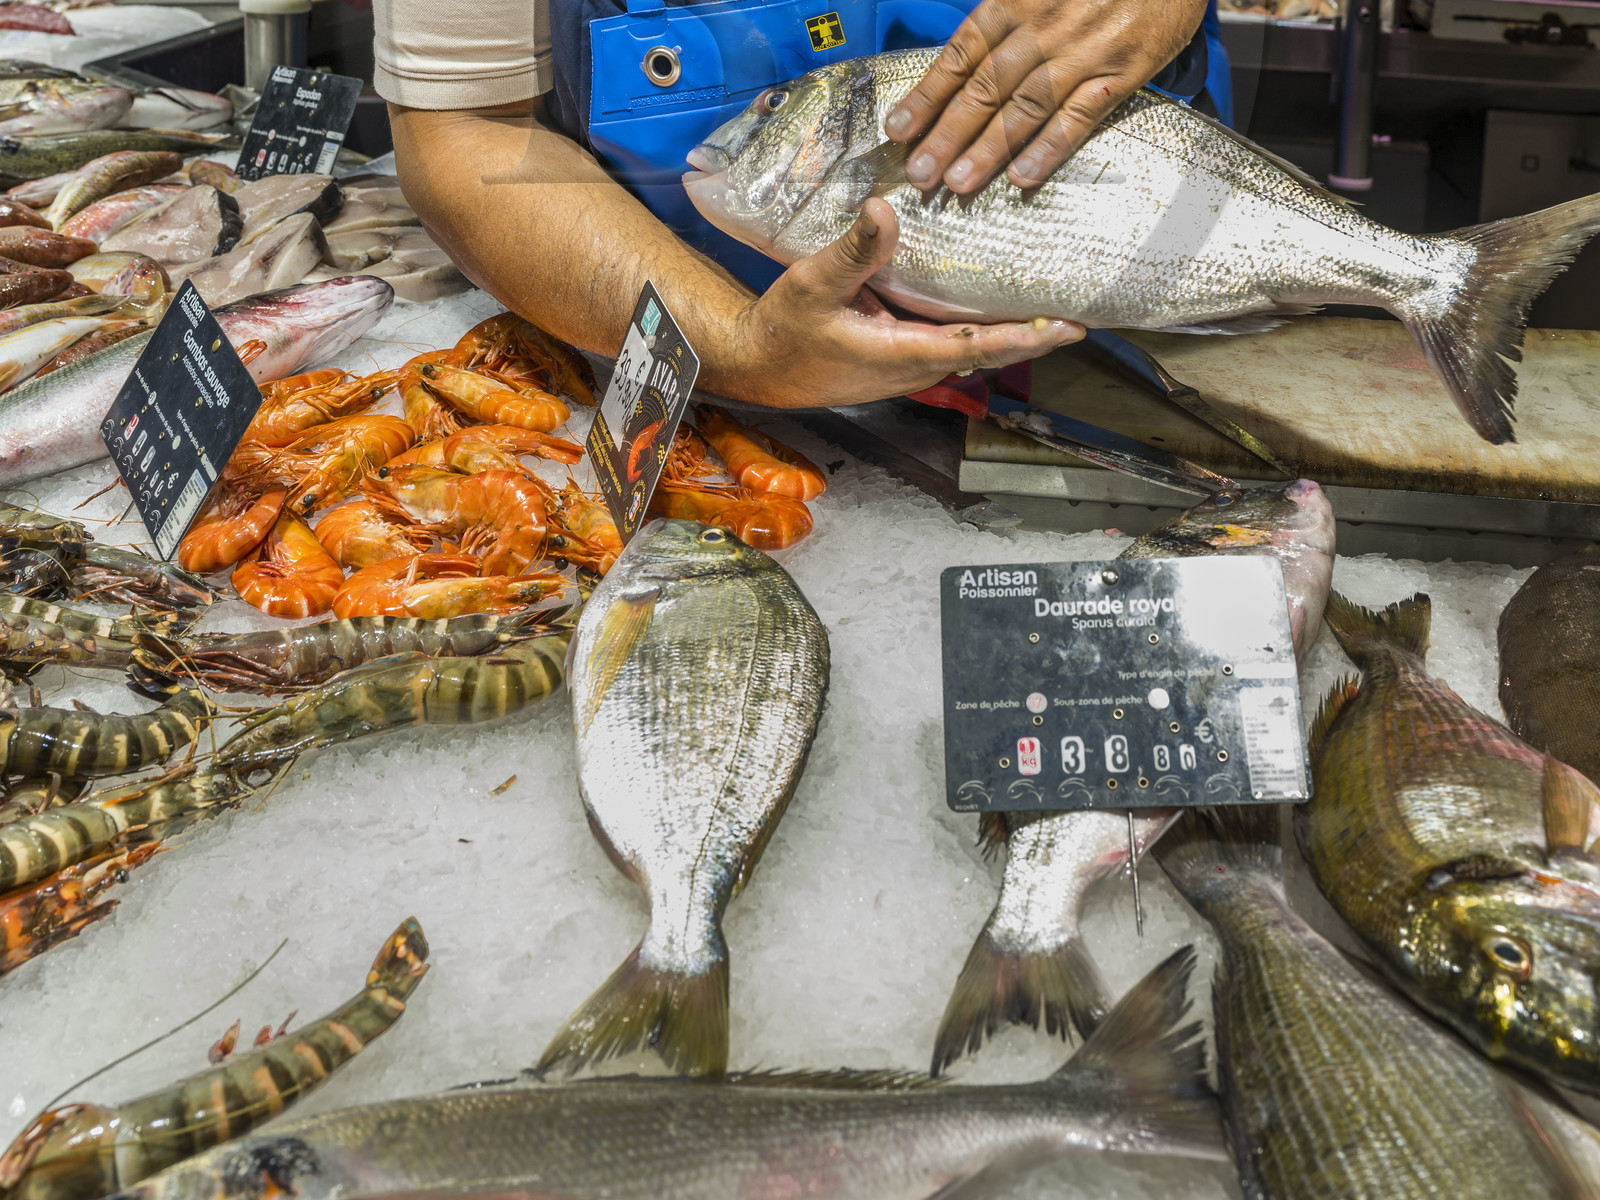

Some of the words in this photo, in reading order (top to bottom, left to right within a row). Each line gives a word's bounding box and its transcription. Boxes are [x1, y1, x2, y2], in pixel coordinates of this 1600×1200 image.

[296, 87, 322, 101] Espadon
[184, 286, 205, 322] Artisan
[184, 329, 207, 372] Gambas
[203, 365, 230, 409] sauvage
[650, 360, 680, 420] AYABA
[960, 570, 1037, 587] Artisan
[959, 586, 1037, 599] Poissonnier
[1035, 595, 1123, 618] Daurade
[1129, 598, 1175, 617] roya
[1072, 617, 1113, 630] Sparus
[1118, 671, 1137, 680] Type
[1140, 669, 1172, 679] d'engin
[1174, 669, 1185, 677] de
[956, 700, 978, 710] Zone
[979, 700, 989, 710] de
[992, 699, 1020, 712] pêche
[1054, 698, 1099, 707] Sous-zone
[1102, 698, 1112, 706] de
[1114, 695, 1143, 708] pêche
[1195, 718, 1213, 743] €
[1021, 756, 1036, 768] kg
